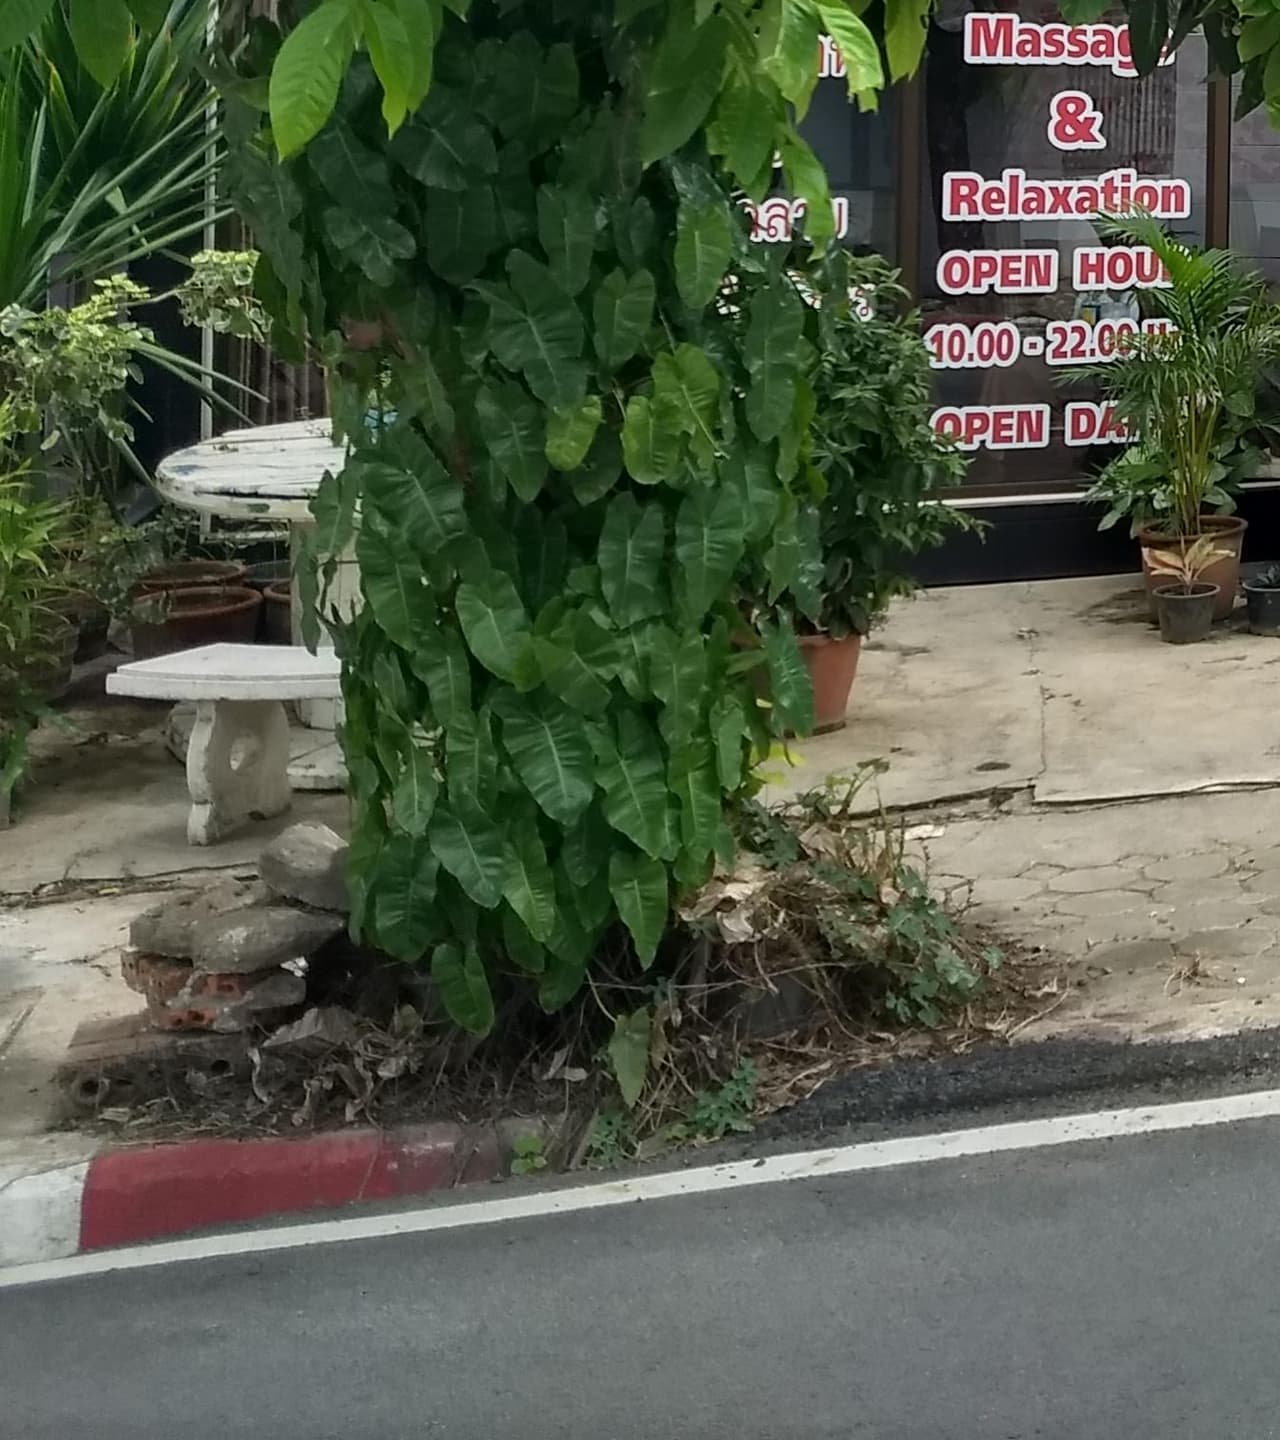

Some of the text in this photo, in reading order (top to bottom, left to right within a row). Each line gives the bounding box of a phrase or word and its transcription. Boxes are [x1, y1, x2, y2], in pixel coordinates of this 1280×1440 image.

[1050, 91, 1102, 150] &
[943, 169, 1190, 221] Relaxation
[937, 249, 1058, 294] OPEN
[926, 323, 1018, 368] 10.00
[1046, 319, 1139, 365] 22.00
[930, 405, 1050, 451] OPEN
